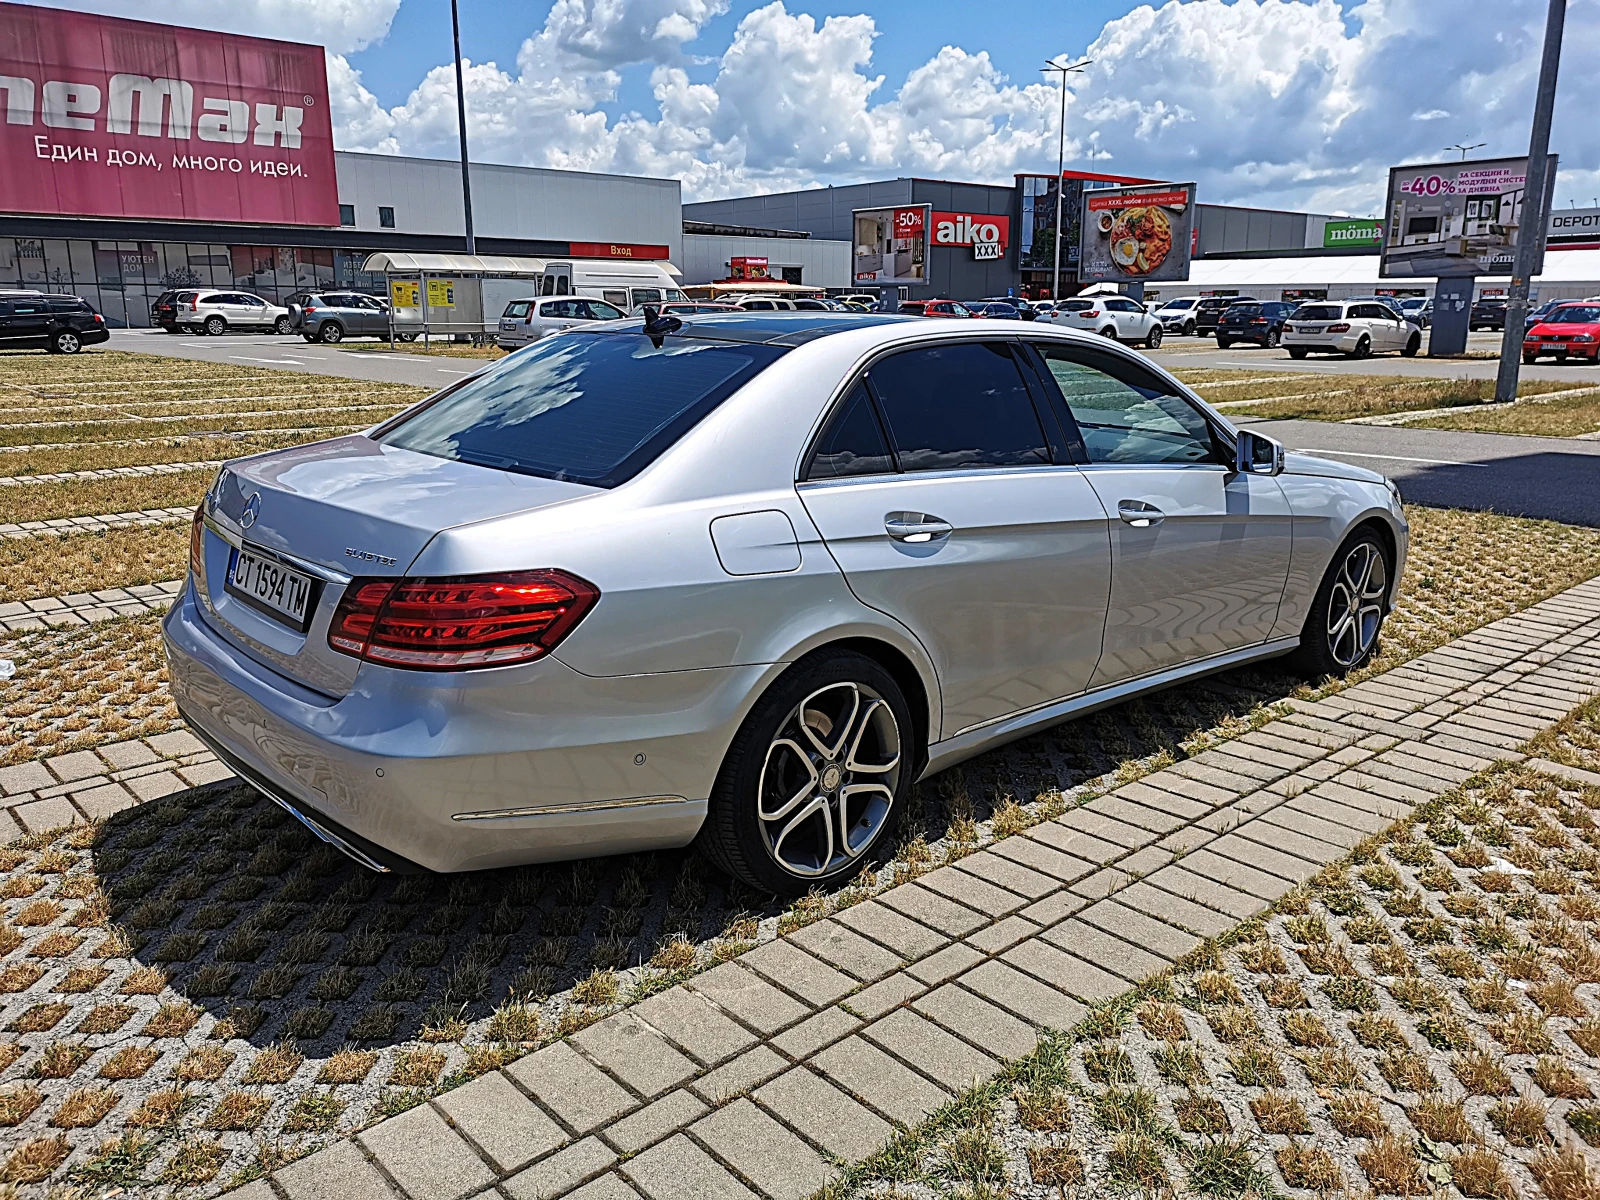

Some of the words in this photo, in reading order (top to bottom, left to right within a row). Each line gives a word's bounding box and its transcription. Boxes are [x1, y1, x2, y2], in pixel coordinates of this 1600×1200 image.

[34, 135, 98, 162] Един
[106, 148, 162, 171] дом,
[172, 155, 243, 173] много
[250, 159, 309, 178] идеи.
[1470, 170, 1502, 178] СЕКЦИИ
[1402, 176, 1456, 195] -40%
[1458, 178, 1497, 186] МОДУЛНИ
[896, 212, 921, 226] -50%
[1553, 215, 1600, 228] DEPOT
[937, 216, 999, 243] aiko
[1330, 225, 1383, 240] möma
[610, 245, 632, 257] Вход
[976, 244, 1003, 257] XXXL
[121, 255, 155, 264] УЮТЕН
[123, 264, 144, 273] ДОМ
[345, 548, 397, 566] BLUETEC
[254, 562, 286, 606] 1594
